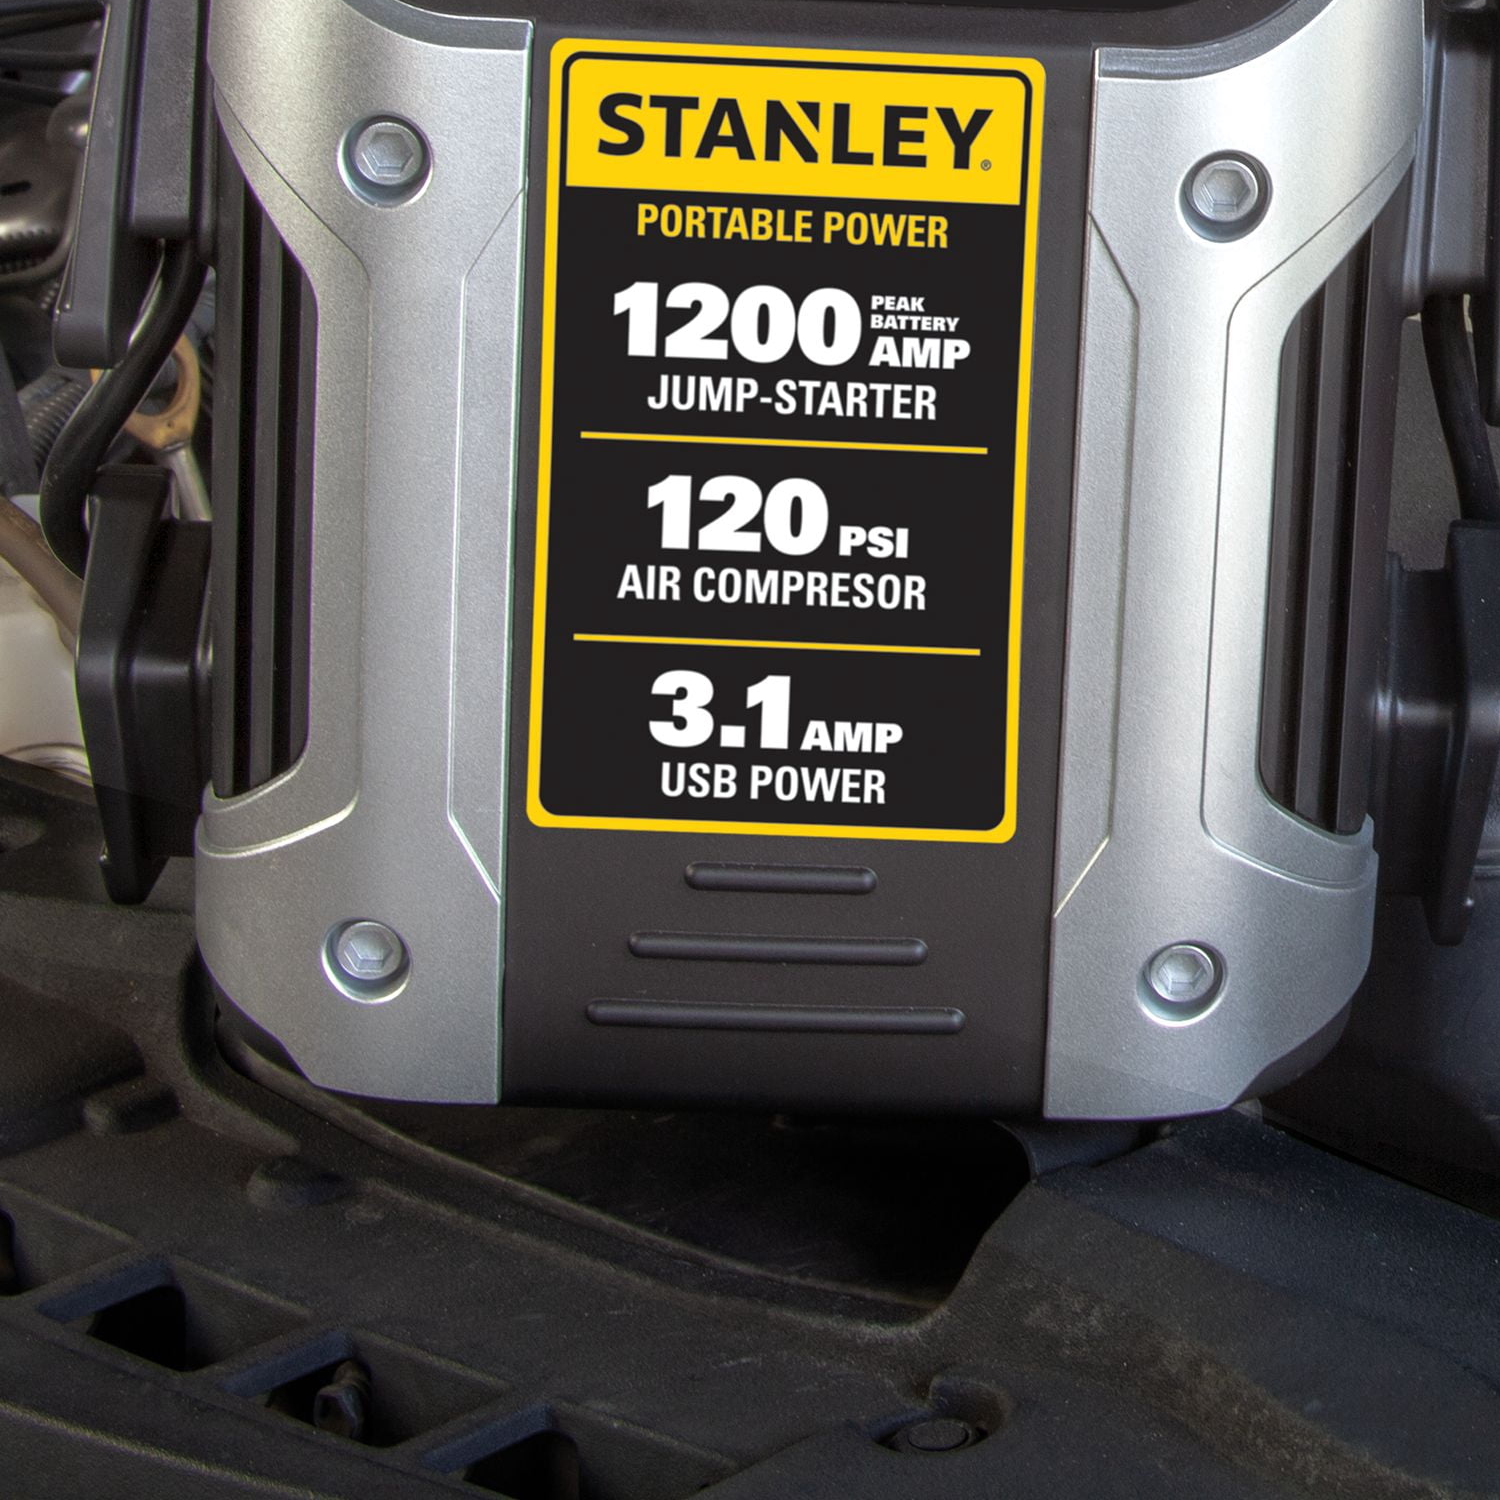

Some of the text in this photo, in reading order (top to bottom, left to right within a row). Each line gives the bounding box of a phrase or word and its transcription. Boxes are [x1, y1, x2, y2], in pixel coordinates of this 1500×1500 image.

[637, 203, 949, 248] PORTABLE POWER
[614, 282, 861, 366] 1200
[871, 294, 925, 313] PEAK
[871, 314, 959, 332] BATTERY
[869, 336, 970, 369] AMP
[648, 375, 936, 420] JUMP-STARTER
[648, 475, 908, 558] 120 PSI
[617, 564, 926, 610] AIR COMPRESOR
[649, 670, 903, 753] 3.1 AMP
[662, 762, 885, 804] USB POWER
